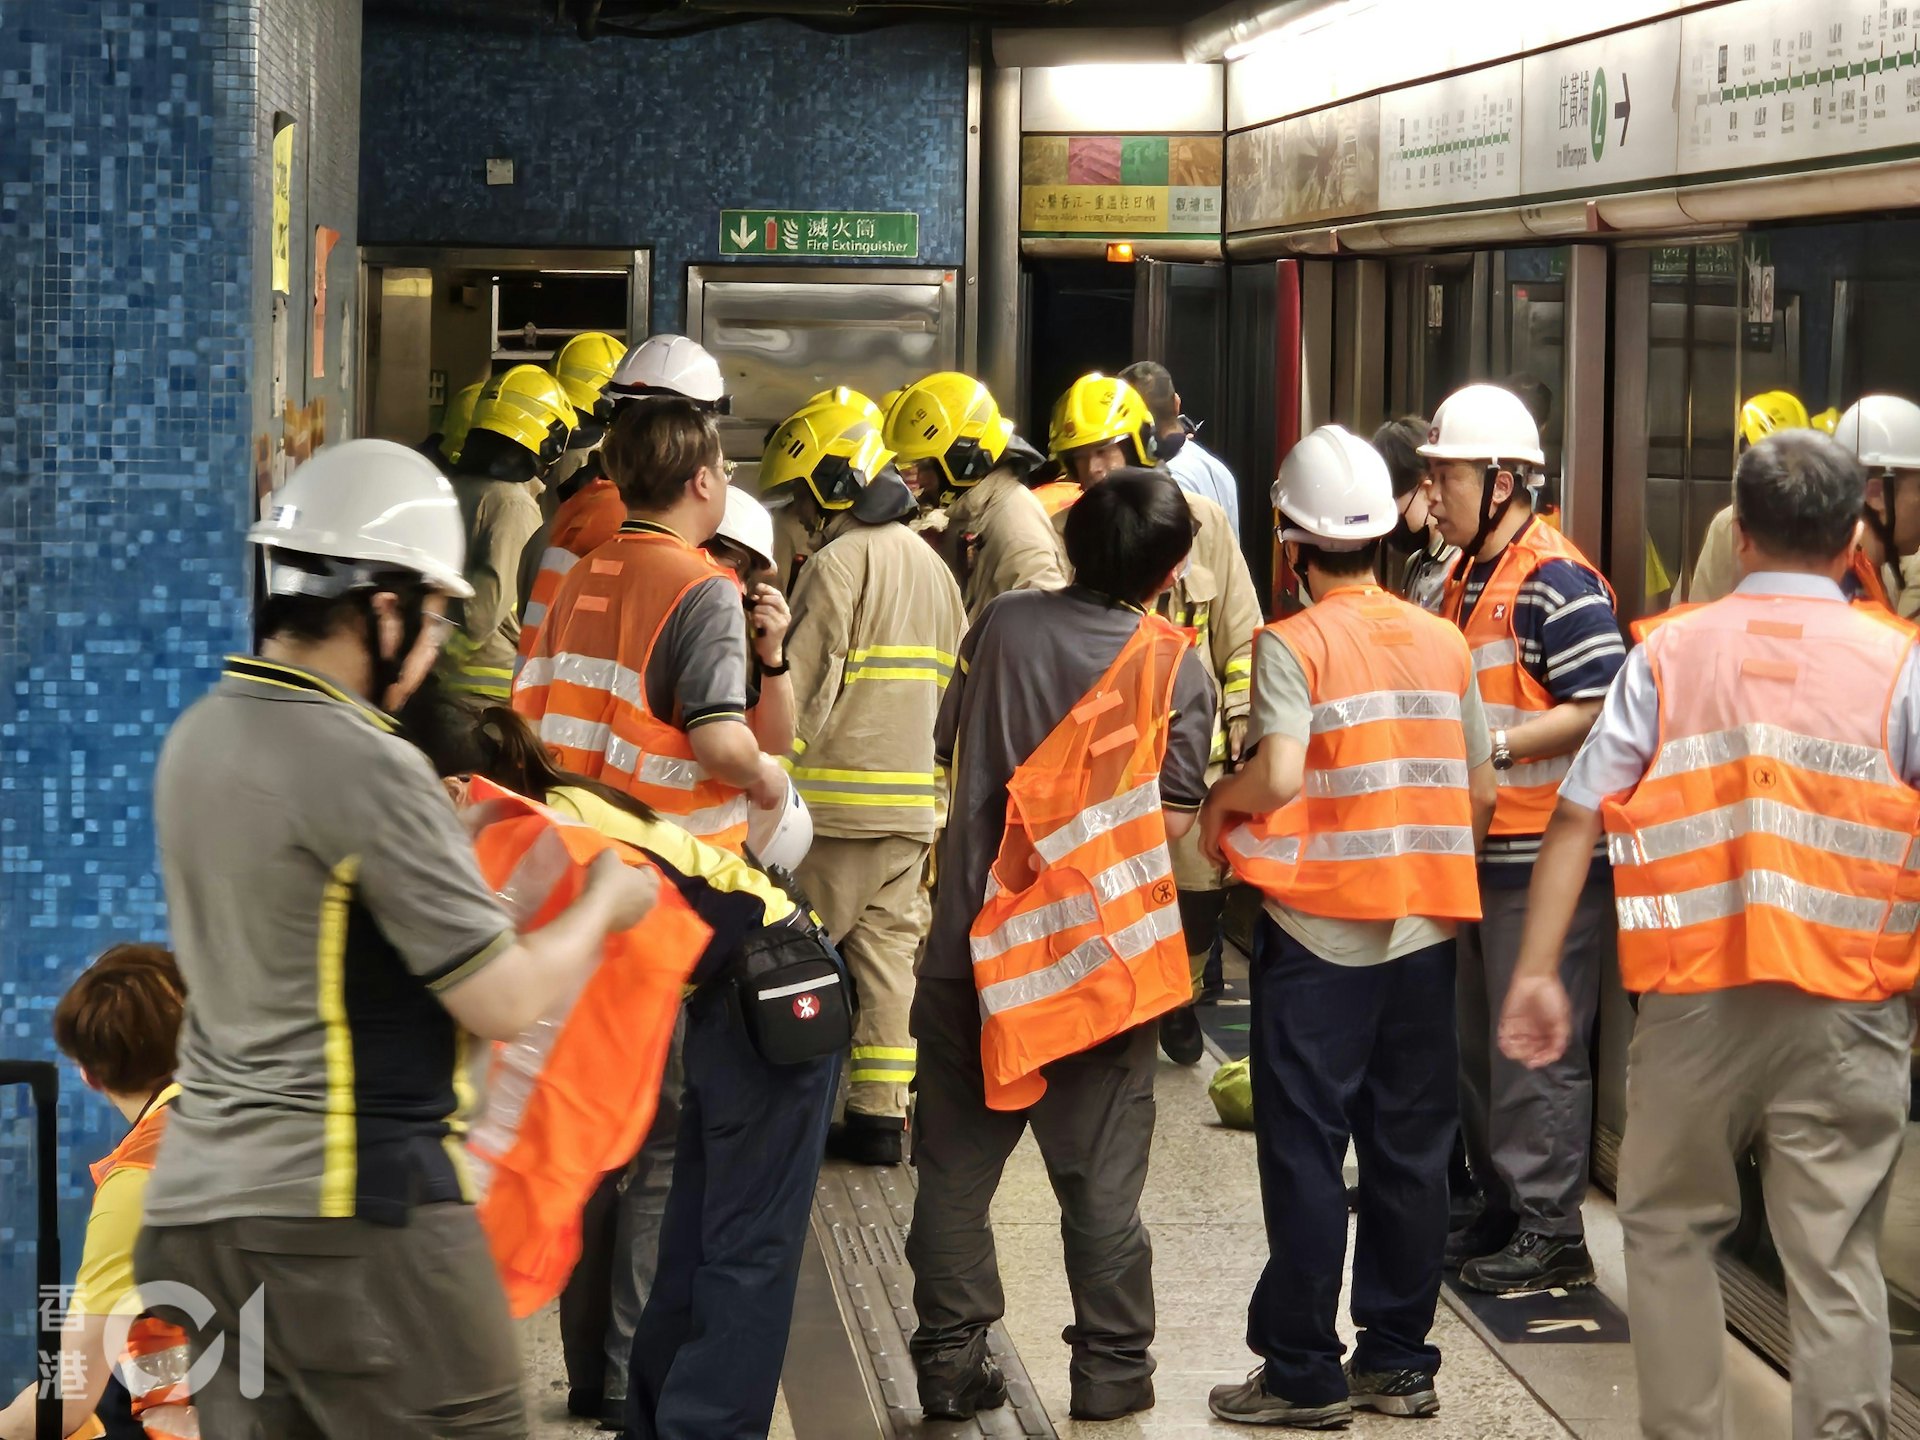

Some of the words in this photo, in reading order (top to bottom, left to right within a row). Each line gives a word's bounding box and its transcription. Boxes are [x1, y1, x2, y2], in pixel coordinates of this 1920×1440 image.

[807, 217, 876, 239] 滅火筒
[806, 239, 830, 251] Fire
[832, 240, 908, 253] Extinguisher
